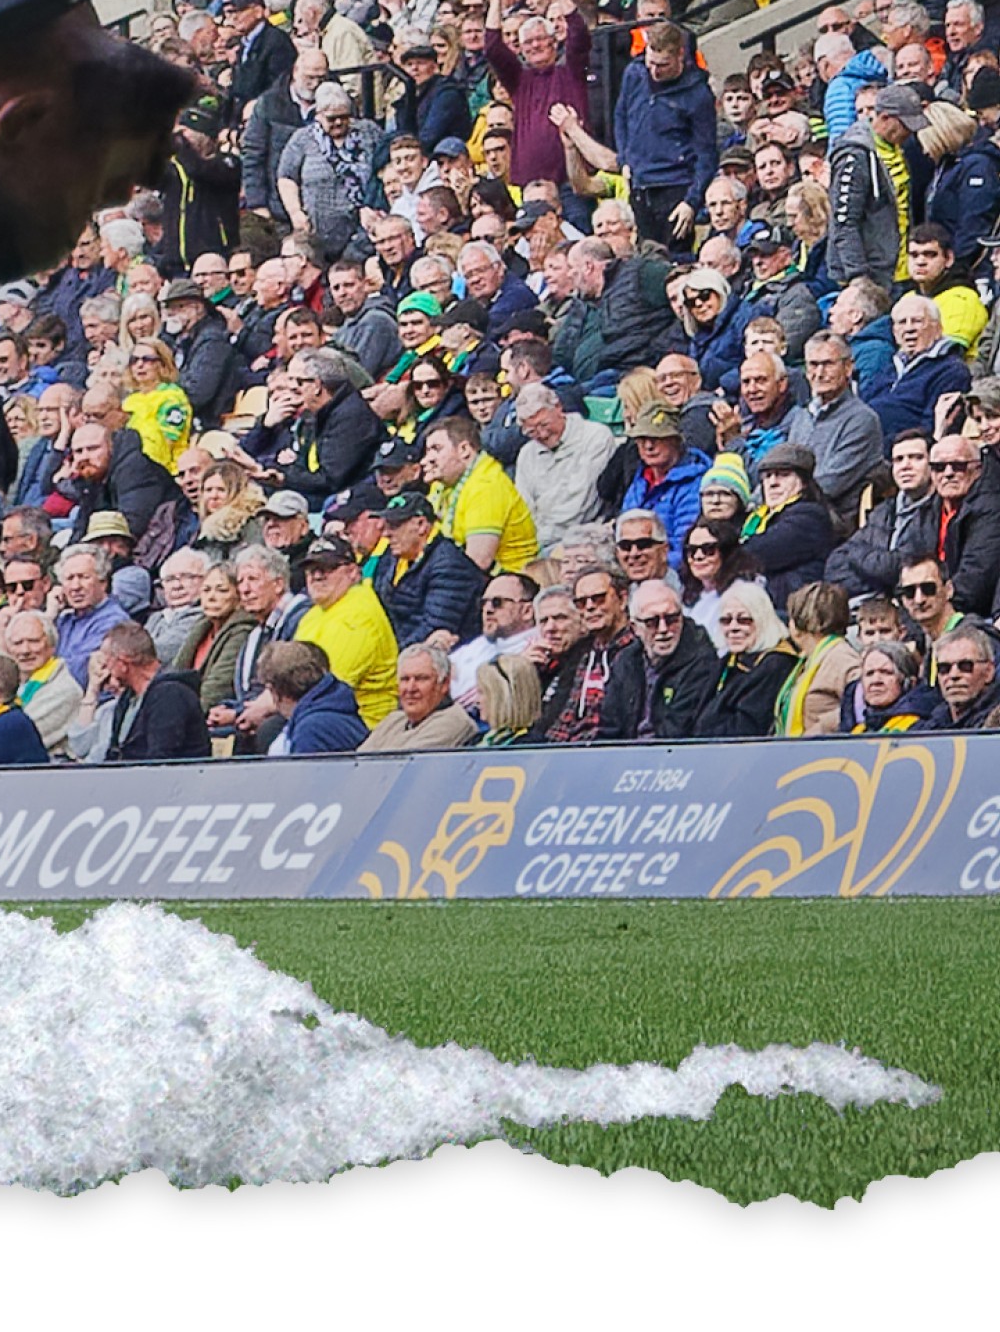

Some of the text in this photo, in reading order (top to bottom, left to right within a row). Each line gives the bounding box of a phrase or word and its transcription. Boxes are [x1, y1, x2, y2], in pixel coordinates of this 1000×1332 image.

[38, 802, 276, 889] COFFEE
[524, 801, 733, 846] GREEN FARM
[515, 851, 646, 894] COFFEE
